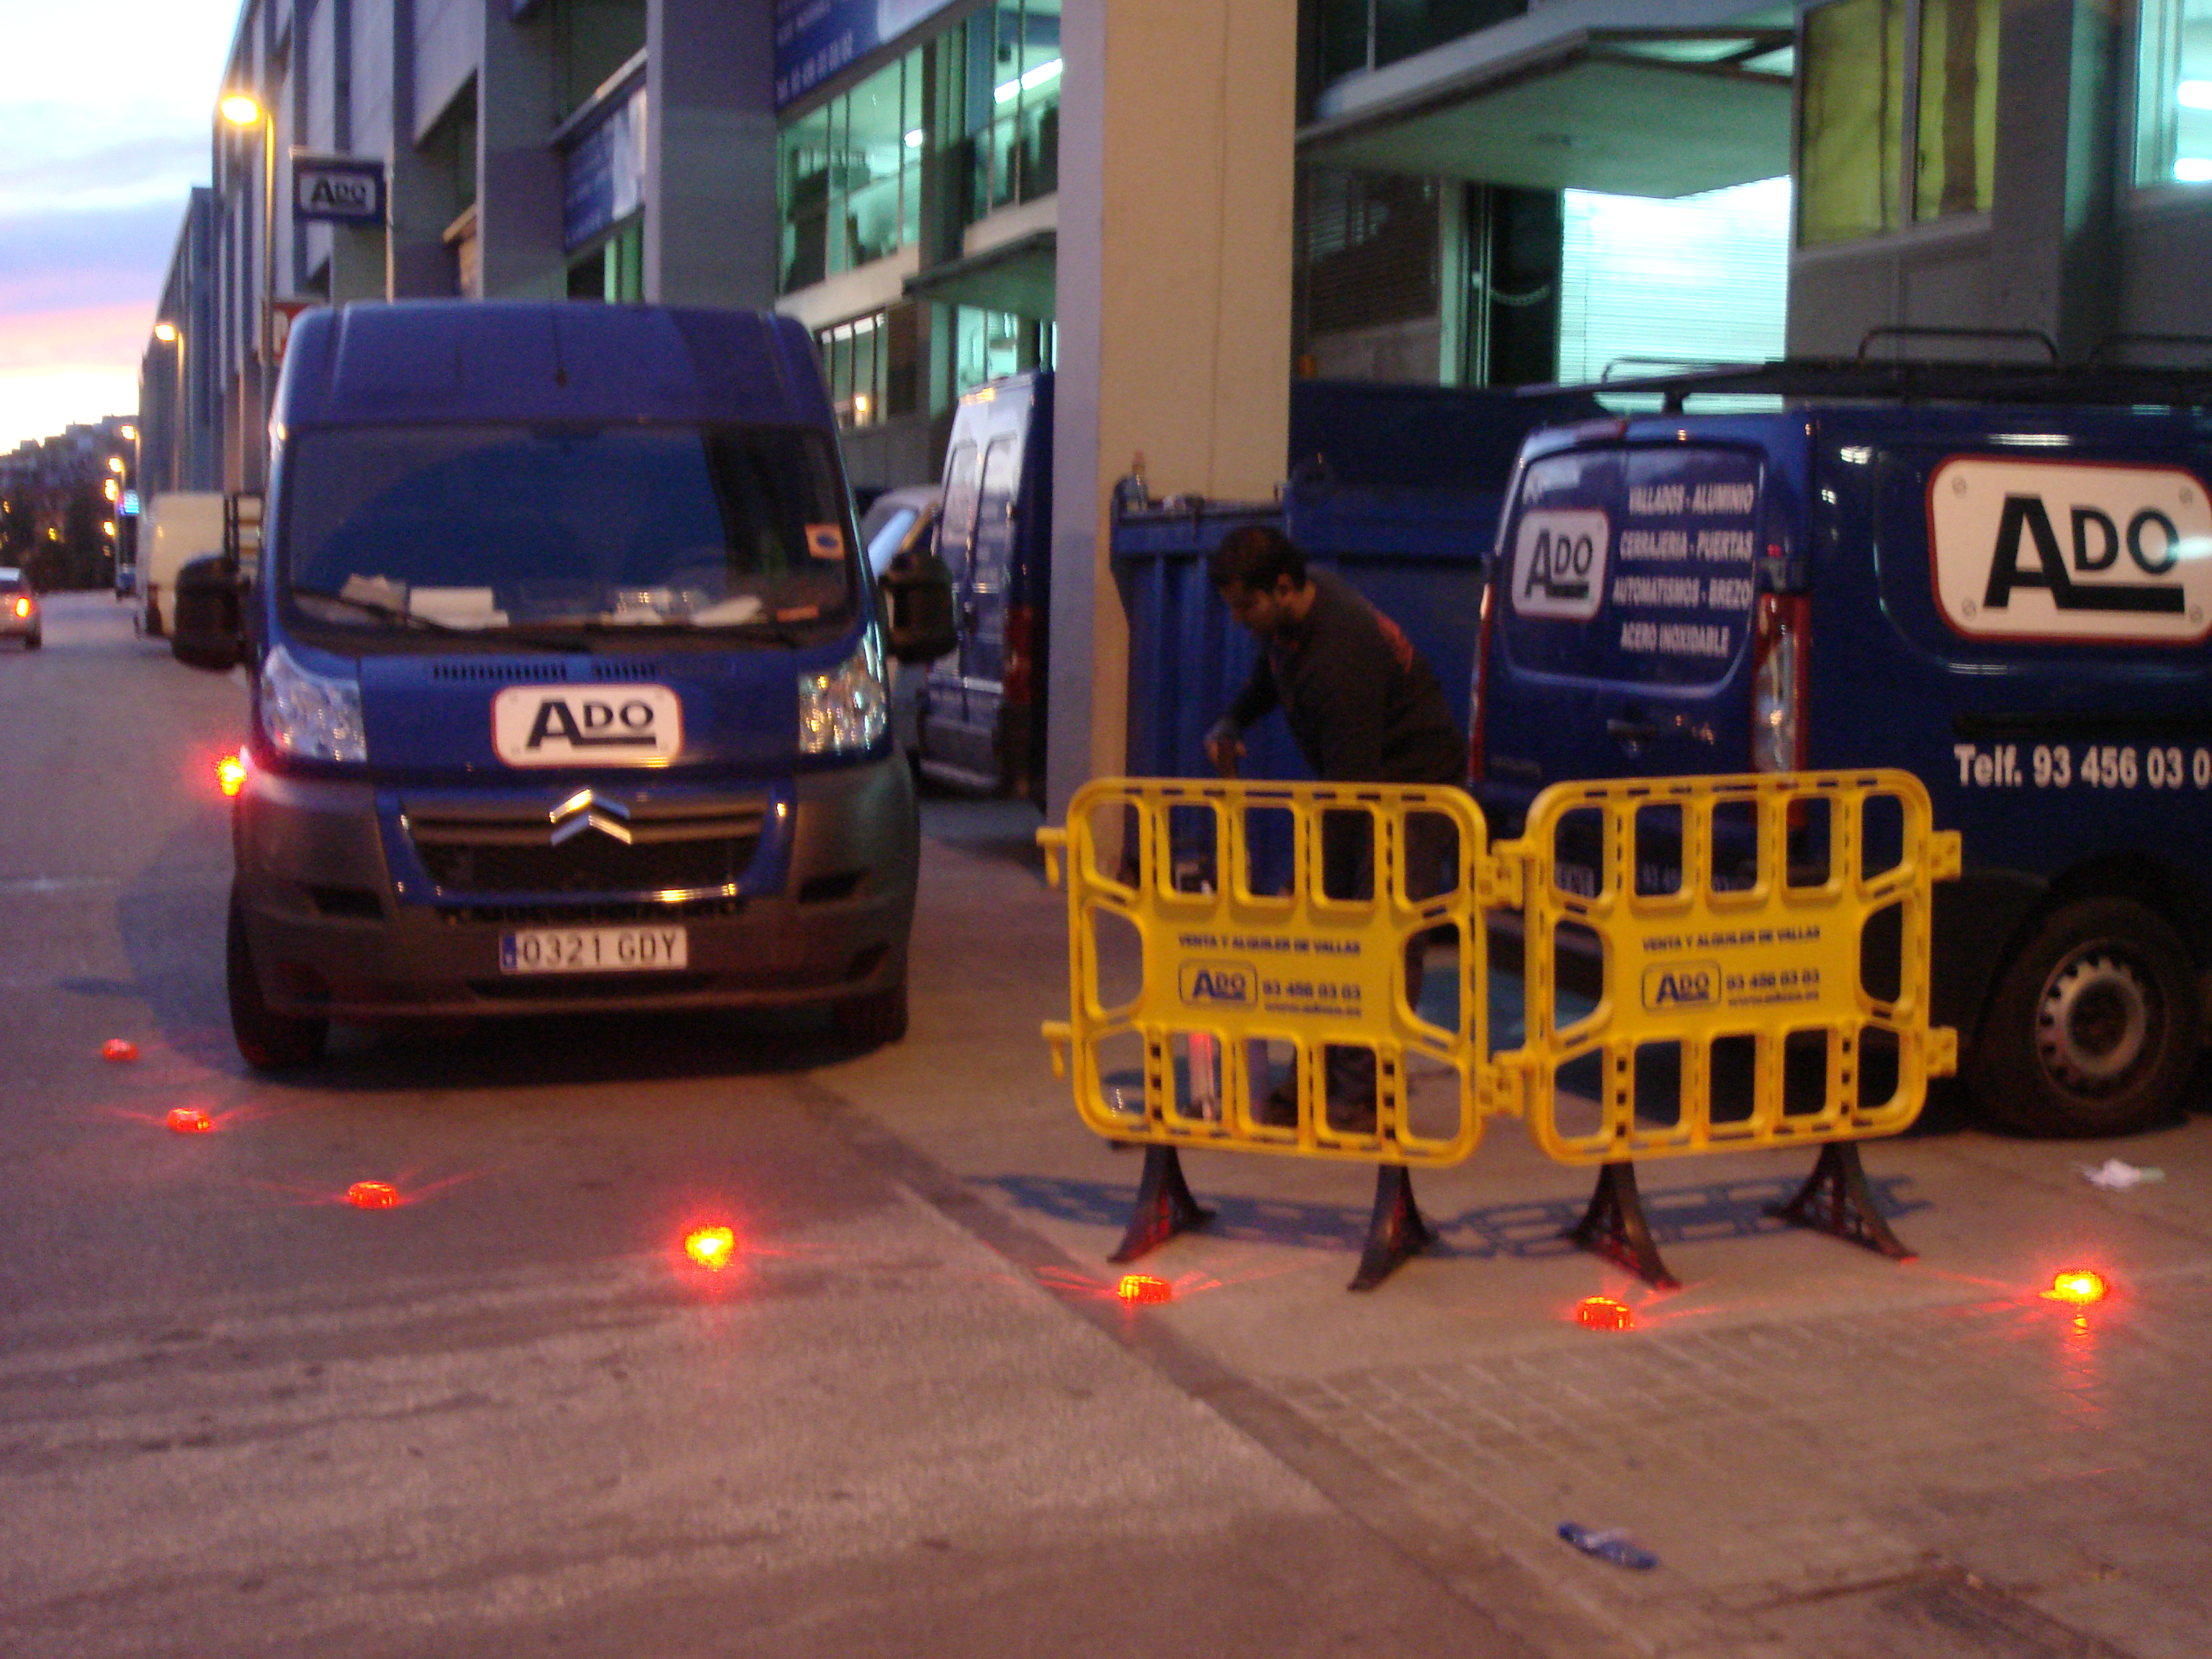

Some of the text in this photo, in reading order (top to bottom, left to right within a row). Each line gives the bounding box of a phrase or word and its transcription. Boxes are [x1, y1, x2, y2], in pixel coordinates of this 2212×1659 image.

[311, 176, 367, 209] ADO
[1696, 530, 1754, 562] PUERTAS
[1982, 493, 2186, 615] ADO
[1524, 528, 1593, 599] ADO
[1622, 621, 1656, 652] ACERO
[526, 696, 657, 750] ADO
[1954, 744, 2023, 787] Telf.
[2033, 744, 2072, 788] 93
[2080, 745, 2138, 788] 456
[2147, 746, 2183, 789] 03
[523, 931, 675, 965] 0321 GDY
[1192, 968, 1246, 1002] ADO
[1657, 972, 1709, 1002] ADO
